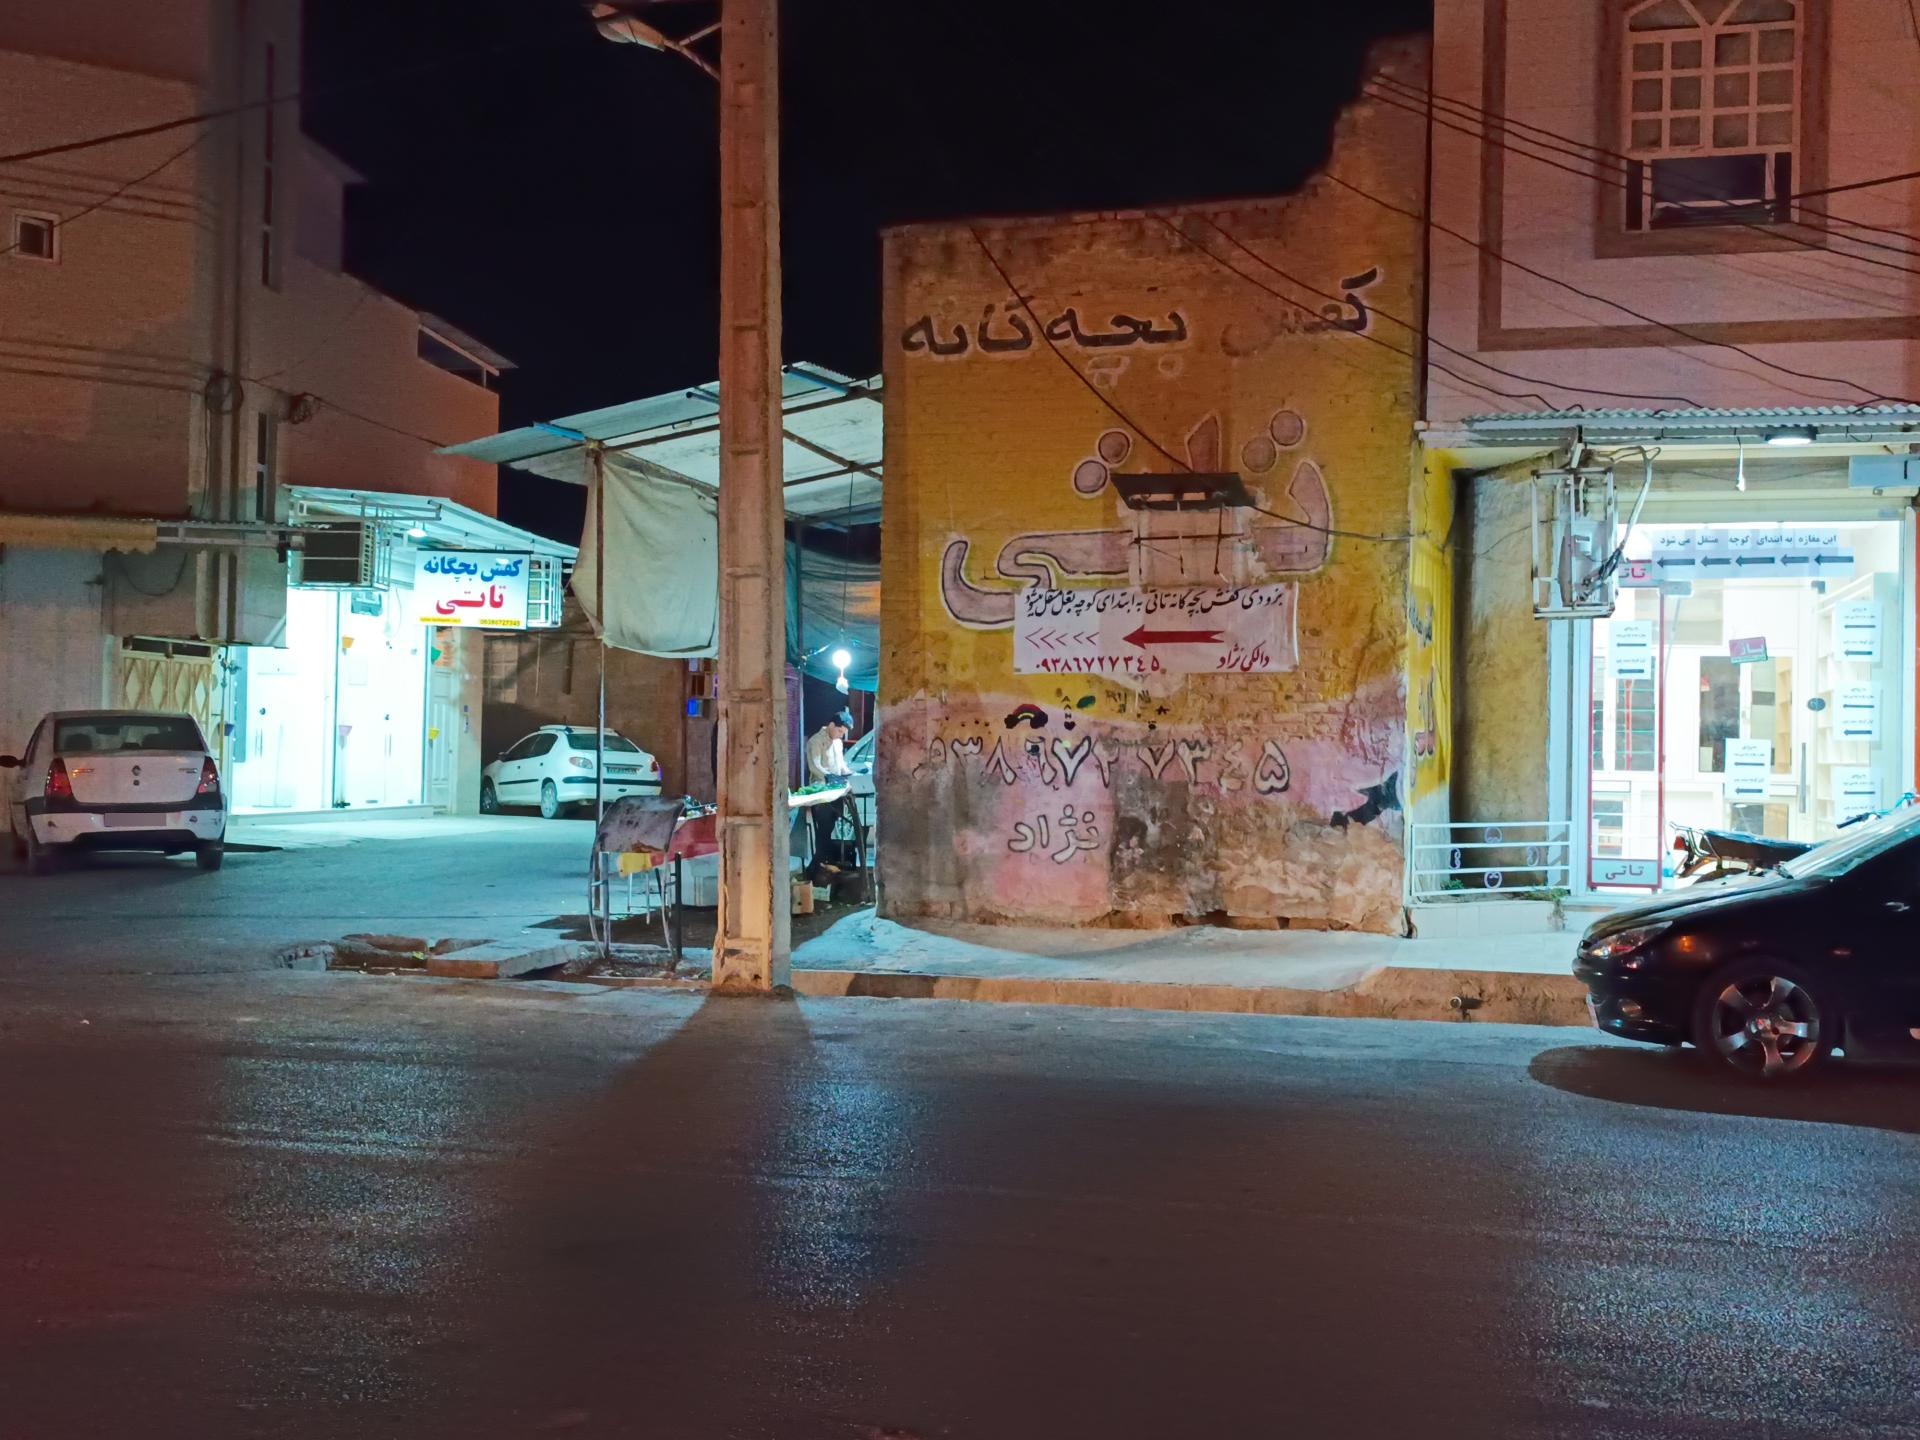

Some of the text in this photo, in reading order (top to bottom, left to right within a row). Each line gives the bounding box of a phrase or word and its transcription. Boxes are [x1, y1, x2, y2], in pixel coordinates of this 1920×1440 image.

[423, 556, 523, 583] کفش بچگانه
[1618, 567, 1647, 579] تات
[436, 584, 507, 615] تاتی
[1075, 588, 1107, 617] کوچه
[1096, 591, 1135, 614] ابتدای
[1145, 589, 1170, 615] تاتی
[1200, 585, 1249, 614] کفش
[1241, 588, 1284, 610] بزودی
[1007, 803, 1101, 865] نژاد
[1604, 864, 1645, 881] تاتی
